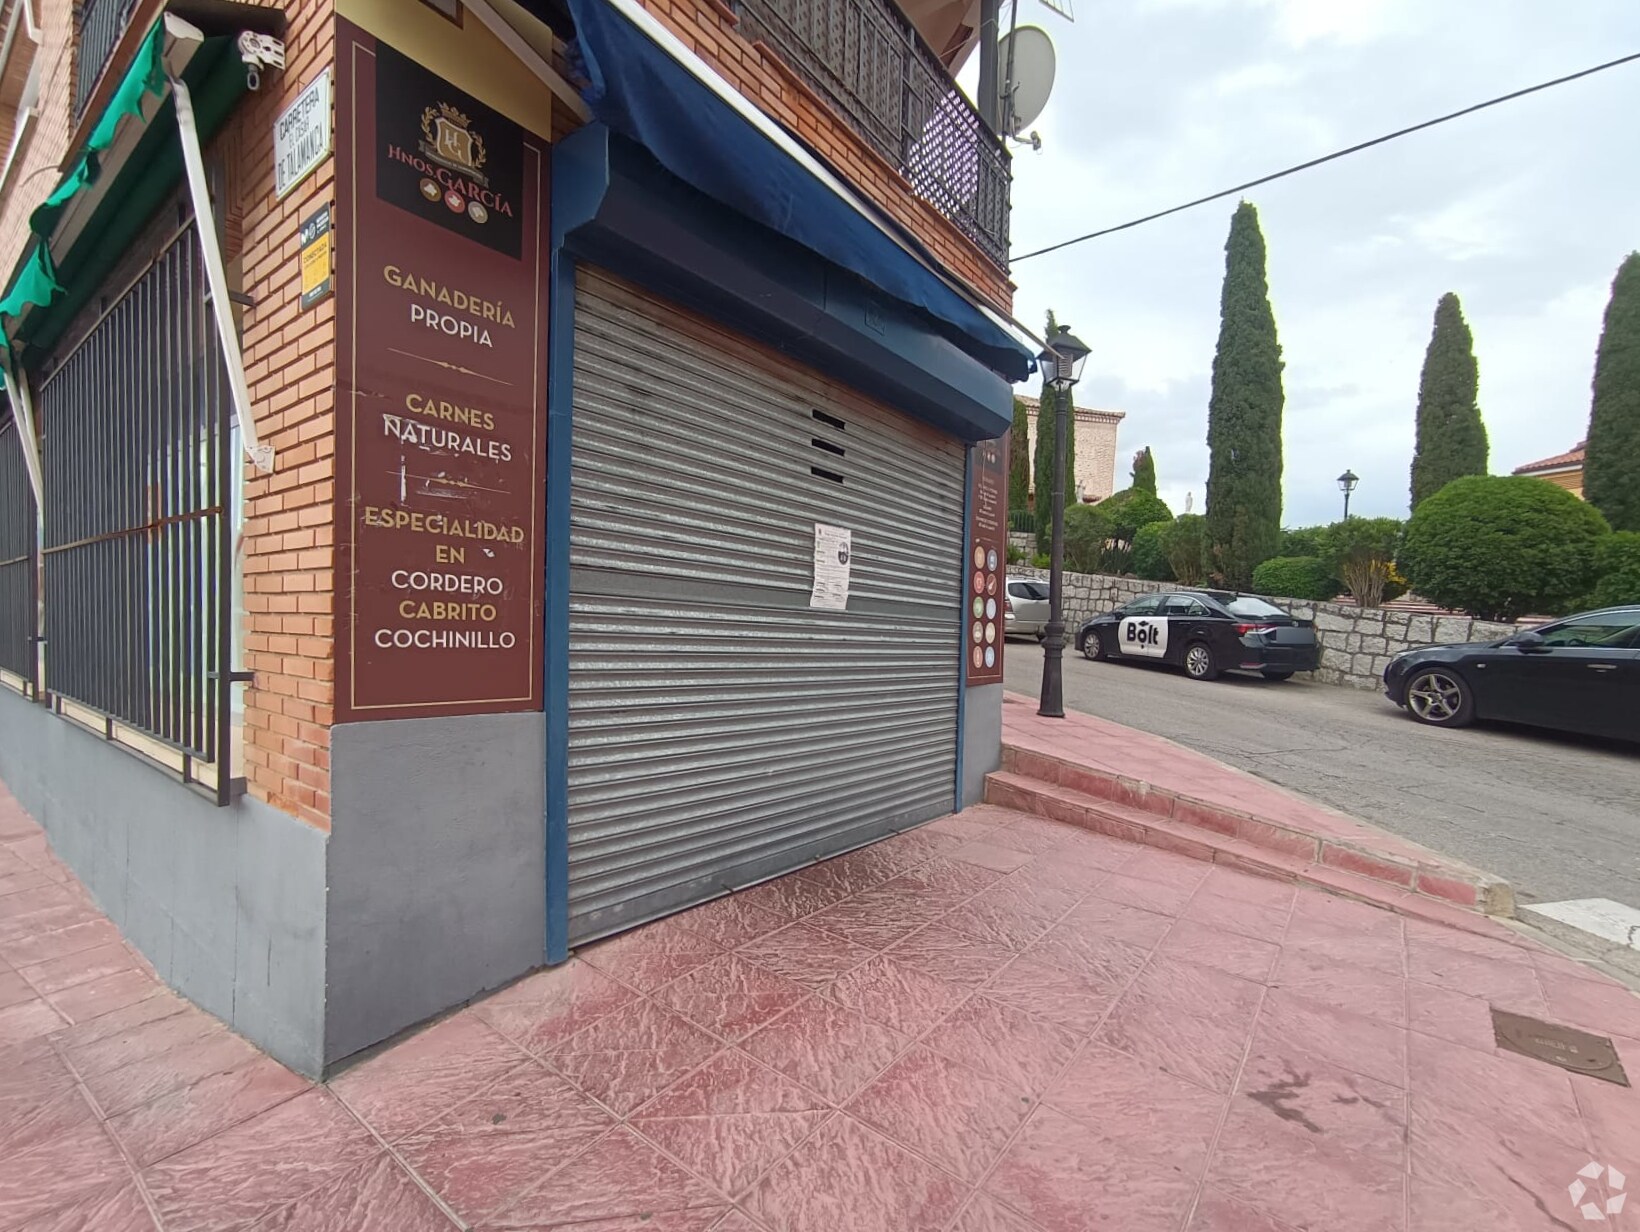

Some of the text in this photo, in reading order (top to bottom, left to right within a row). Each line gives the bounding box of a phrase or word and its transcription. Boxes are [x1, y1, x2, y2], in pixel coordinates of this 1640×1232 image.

[280, 87, 320, 140] CARRETERA
[278, 122, 324, 190] DE TALAMANCA
[383, 264, 516, 329] GANADERÍA
[410, 303, 493, 348] PROPIA
[405, 393, 495, 431] CARNES
[383, 415, 512, 462] NATURALES
[365, 506, 525, 544] ESPECIALIDAD
[435, 545, 465, 564] EN
[391, 570, 503, 595] CORDERO
[399, 600, 497, 621] CABRITO
[374, 629, 516, 649] COCHINILLO
[1127, 621, 1159, 647] Bolt
